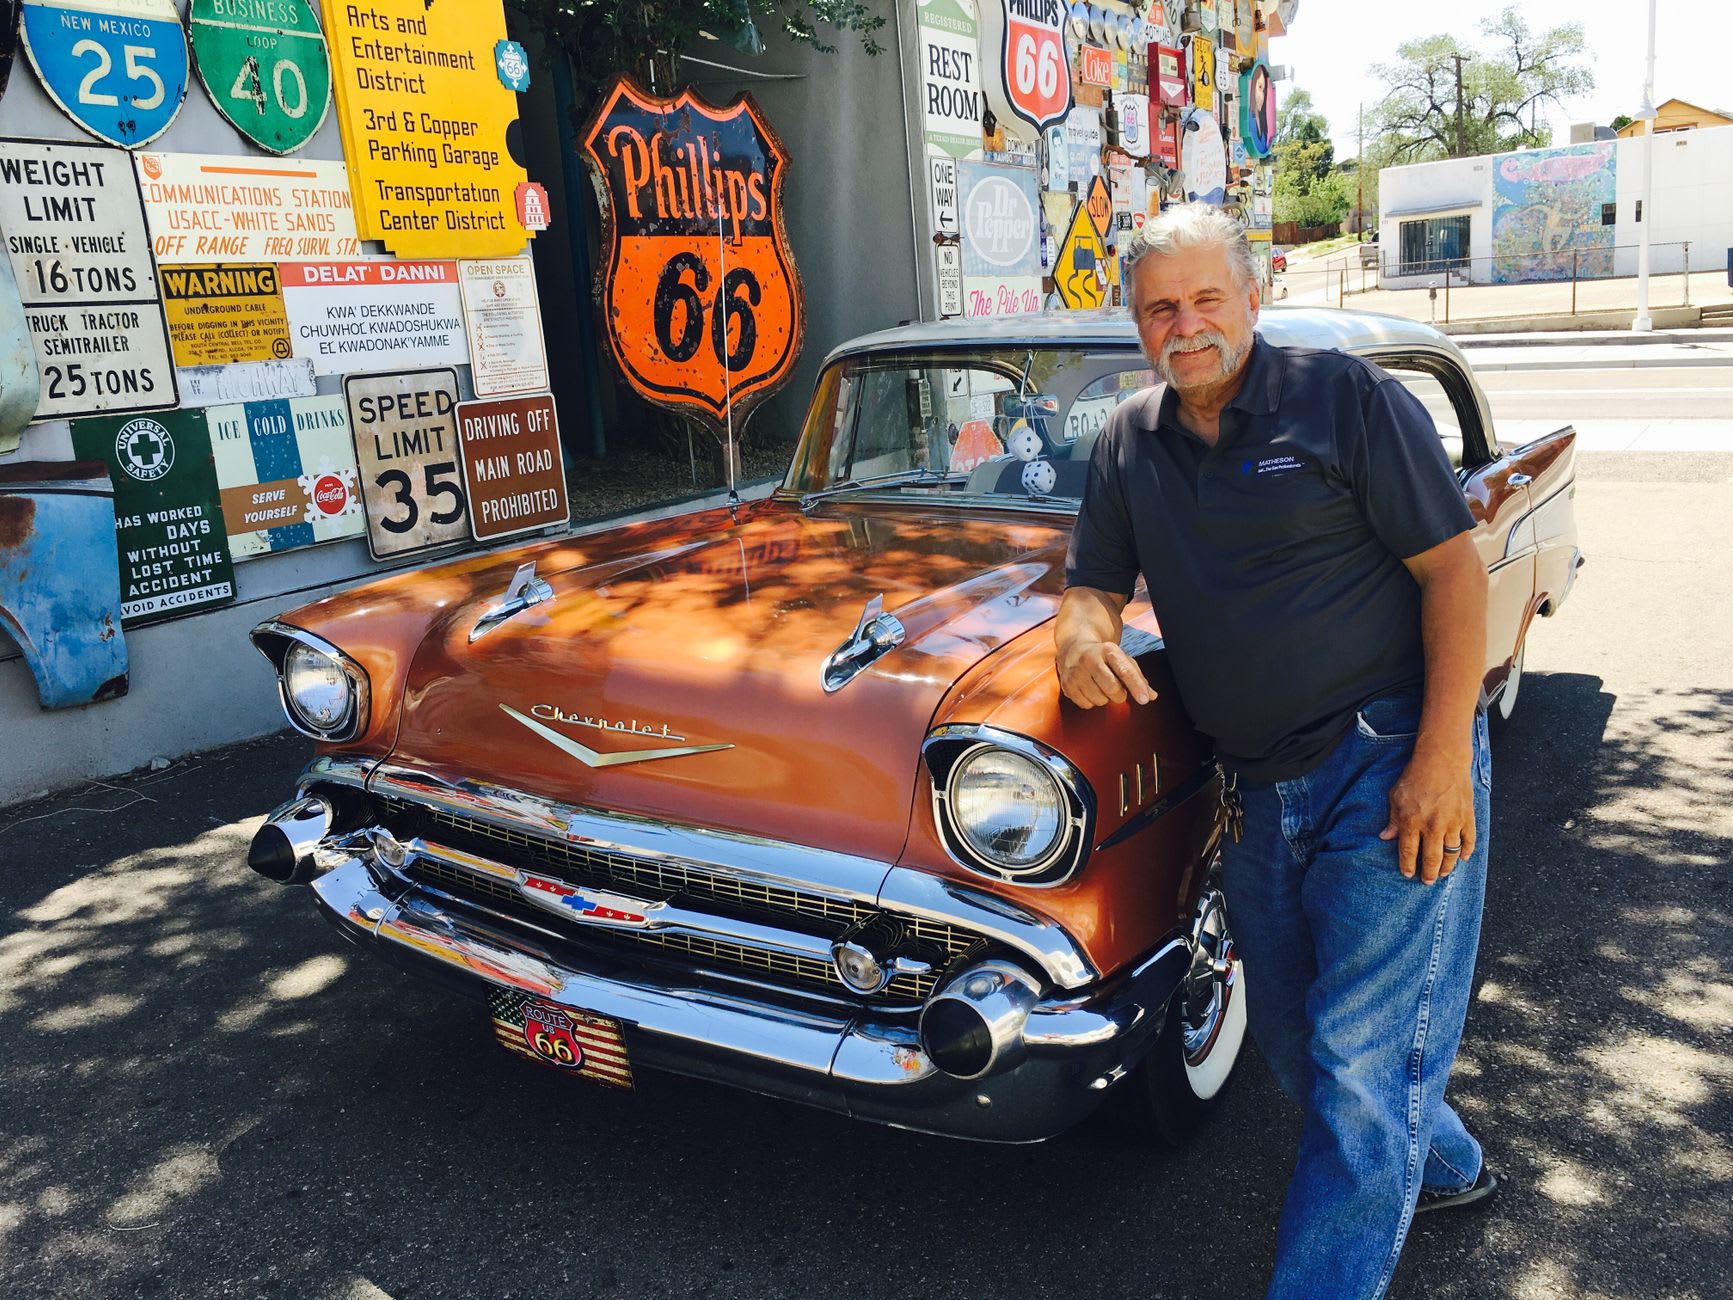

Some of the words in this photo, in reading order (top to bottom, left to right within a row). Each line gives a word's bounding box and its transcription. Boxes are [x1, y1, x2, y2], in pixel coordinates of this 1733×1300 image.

[214, 0, 299, 24] BUSINESS
[346, 5, 389, 31] Arts
[396, 15, 427, 36] and
[924, 11, 972, 33] REGISTERED
[1009, 0, 1059, 27] PHILLIPS
[60, 14, 91, 32] NEW
[99, 18, 151, 38] MEXICO
[246, 36, 278, 50] LOOP
[351, 36, 476, 71] Entertainment
[71, 39, 166, 110] 25
[507, 62, 521, 75] 66
[928, 44, 972, 83] REST
[1015, 33, 1059, 100] 66
[1084, 48, 1109, 84] Coke
[230, 55, 308, 119] 40
[356, 67, 426, 94] District
[927, 83, 979, 122] ROOM
[363, 109, 397, 132] 3rd
[403, 112, 415, 132] &
[421, 113, 478, 141] Copper
[368, 139, 438, 168] Parking
[443, 143, 499, 170] Garage
[1, 158, 104, 187] WEIGHT
[607, 124, 767, 246] Phillips
[935, 163, 954, 184] ONE
[292, 188, 351, 209] STATION
[375, 179, 500, 206] Transportation
[936, 187, 954, 207] WAY
[993, 185, 1018, 217] Dr
[23, 195, 96, 222] LIMIT
[380, 210, 439, 231] Center
[444, 210, 506, 231] District
[1091, 196, 1109, 218] SLOW
[285, 213, 336, 232] SANDS
[975, 201, 1029, 253] Pepper
[9, 236, 59, 254] SINGLE
[71, 236, 126, 254] VEHICLE
[155, 235, 187, 256] OFF
[195, 235, 249, 256] RANGE
[264, 236, 293, 256] FREQ
[296, 237, 331, 256] SURVL
[944, 251, 953, 264] NO
[34, 260, 69, 294] 16
[71, 266, 137, 293] TONS
[164, 270, 275, 296] WARNING
[303, 264, 372, 284] DELAT'
[380, 264, 446, 281] DANNI
[467, 265, 493, 276] OPEN
[495, 264, 525, 275] SPACE
[184, 304, 242, 316] UNDERGROUND
[245, 303, 266, 313] CABLE
[361, 303, 436, 317] DEKKWANDE
[654, 251, 763, 373] 66
[966, 289, 993, 317] The
[996, 284, 1020, 315] Pile
[26, 314, 69, 333] TRUCK
[80, 312, 140, 330] TRACTOR
[170, 322, 195, 332] BEFORE
[198, 320, 228, 330] DIGGING
[230, 320, 238, 329] IN
[241, 319, 255, 329] THIS
[257, 317, 284, 327] VICINITY
[199, 331, 215, 341] CALL
[217, 330, 249, 340] (COLLECT)
[251, 329, 261, 337] OR
[263, 327, 285, 336] NOTIFY
[368, 318, 461, 335] KWADOSHUKWA
[44, 336, 130, 356] SEMITRAILER
[44, 364, 87, 399] 25
[90, 369, 155, 396] TONS
[358, 389, 451, 424] SPEED
[118, 420, 170, 450] UNIVERSAL
[217, 420, 241, 441] ICE
[253, 415, 287, 437] COLD
[295, 408, 346, 432] DRINKS
[465, 411, 520, 441] DRIVING
[527, 408, 550, 433] OFF
[374, 426, 446, 461] LIMIT
[126, 458, 170, 478] SAFETY
[475, 457, 510, 482] MAIN
[517, 448, 552, 475] ROAD
[1258, 456, 1294, 466] MATHESON
[252, 489, 286, 505] SERVE
[375, 461, 465, 534] 35
[481, 488, 559, 524] PROHIBITED
[115, 515, 142, 529] HAS
[147, 505, 203, 524] WORKED
[244, 505, 298, 523] YOURSELF
[166, 519, 211, 540] DAYS
[127, 539, 201, 563] WITHOUT
[131, 560, 174, 579] LOST
[184, 551, 223, 568] TIME
[129, 569, 212, 596] ACCIDENT
[160, 585, 230, 607] ACCIDENTS
[530, 704, 687, 742] Chevrolet
[526, 1006, 566, 1027] ROUTE
[534, 1032, 573, 1062] 66
